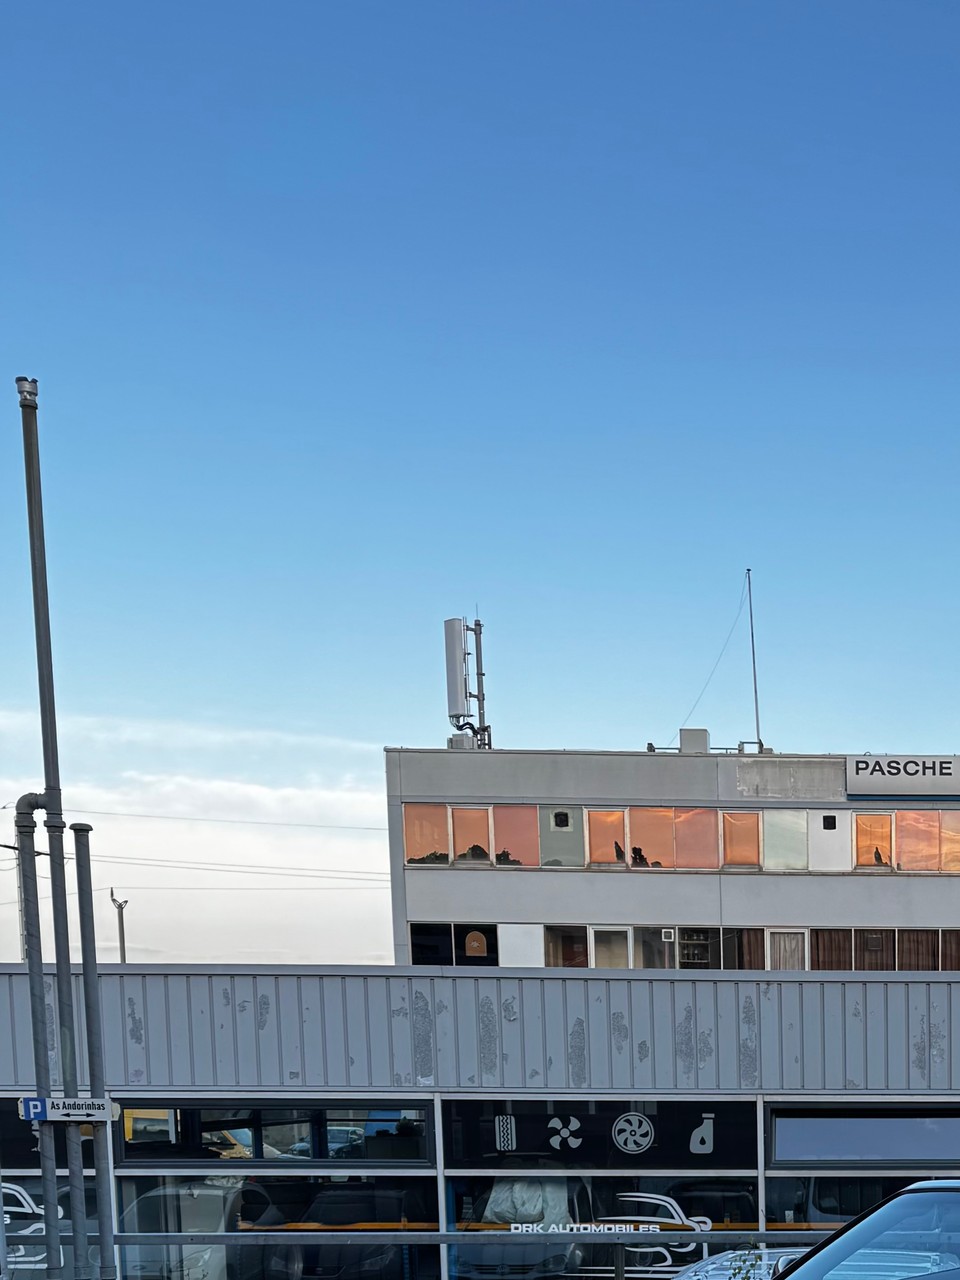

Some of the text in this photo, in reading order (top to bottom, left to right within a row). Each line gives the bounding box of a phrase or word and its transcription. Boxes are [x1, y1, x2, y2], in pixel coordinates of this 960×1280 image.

[855, 760, 953, 776] PASCHE
[29, 1101, 106, 1119] P As Andorinhas
[510, 1223, 661, 1233] DRK AUTOMOBILES
